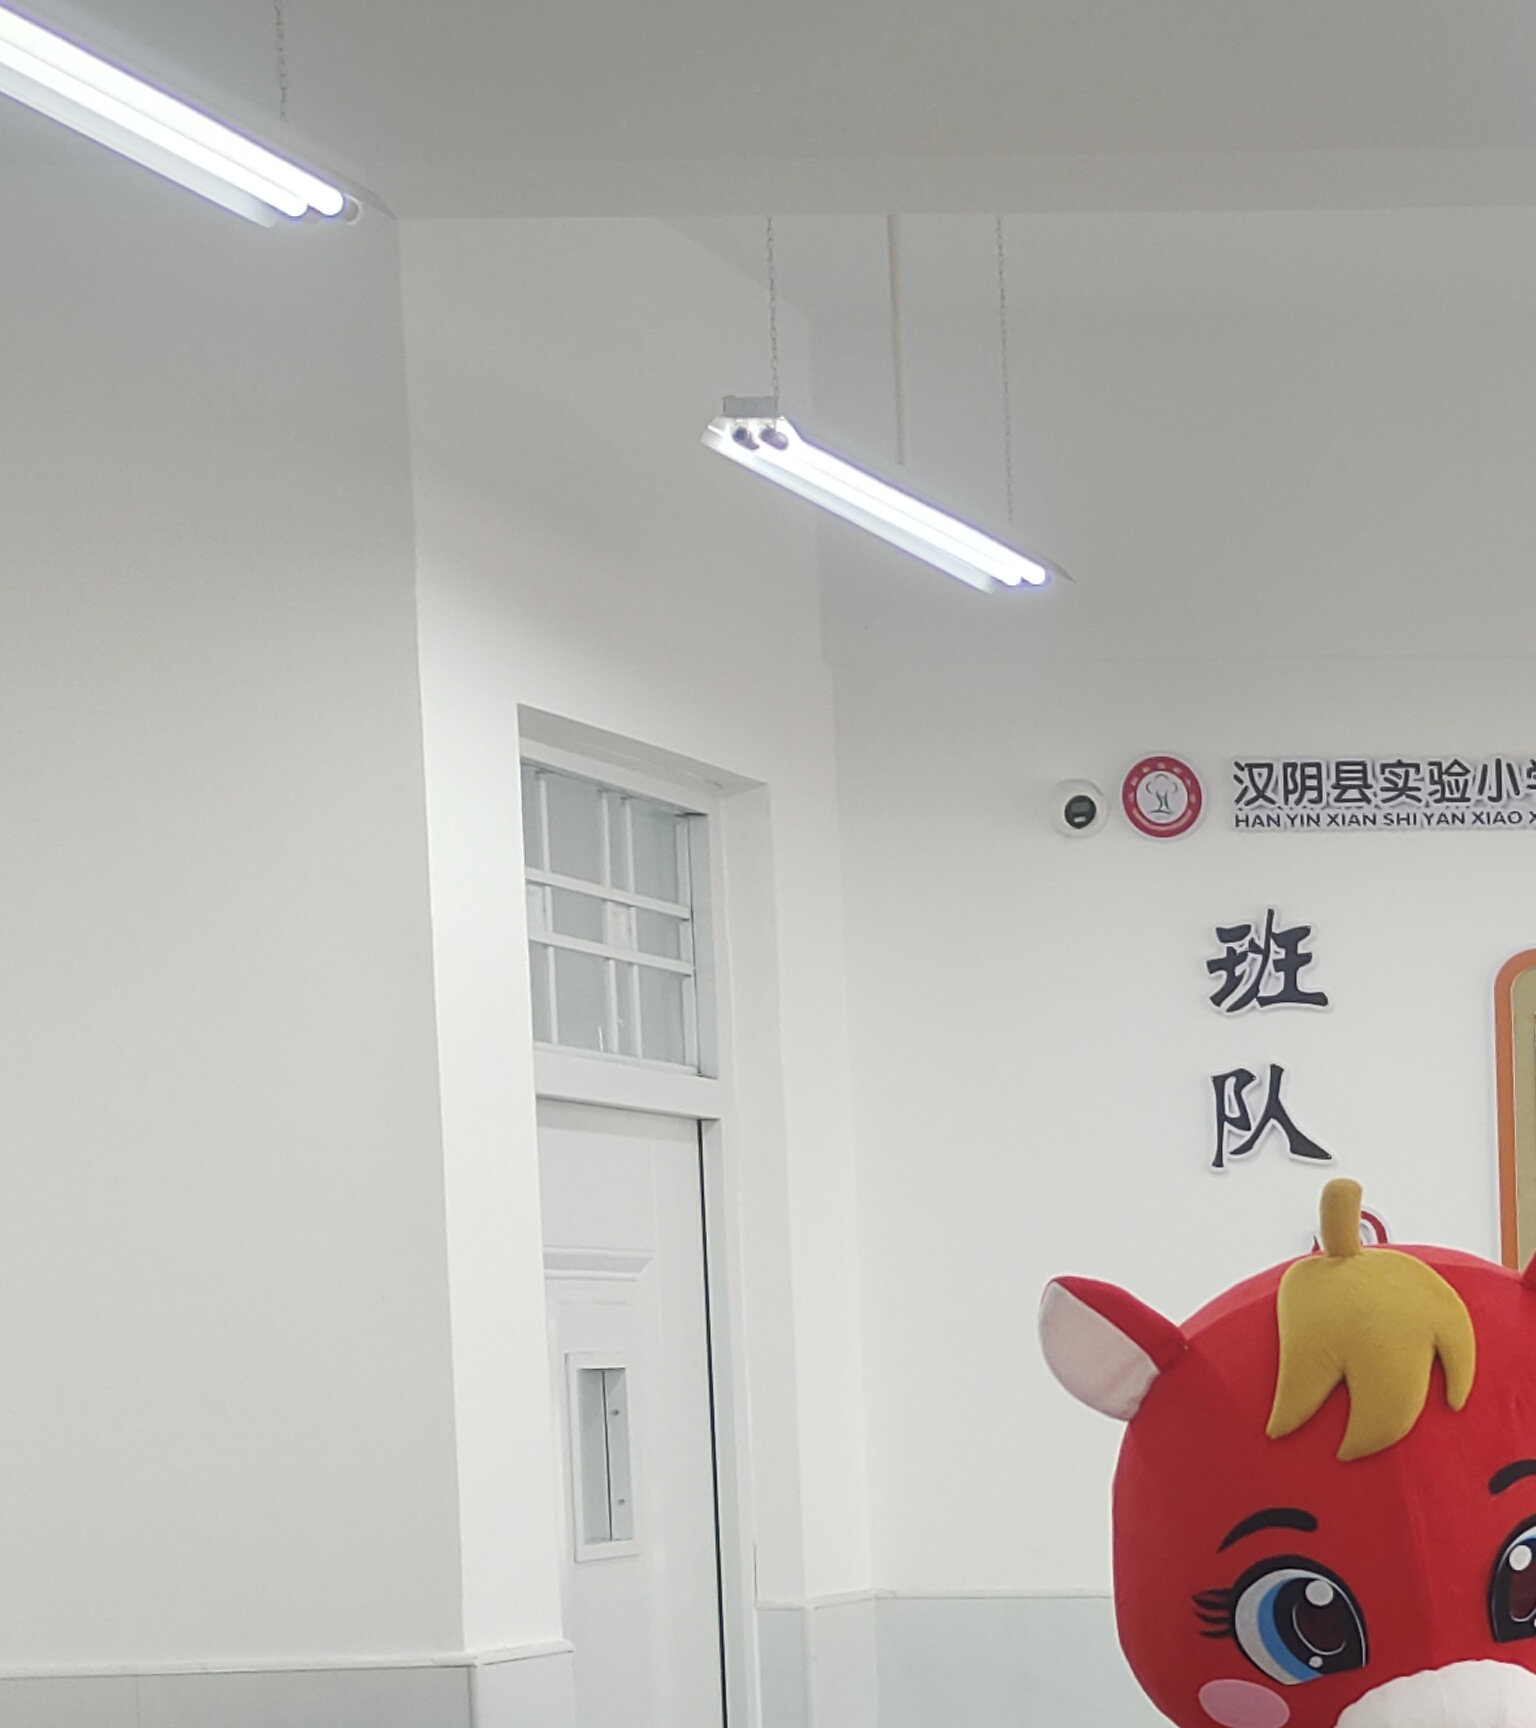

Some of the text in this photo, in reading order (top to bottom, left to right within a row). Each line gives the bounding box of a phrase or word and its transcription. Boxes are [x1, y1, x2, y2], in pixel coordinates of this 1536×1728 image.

[1235, 813, 1281, 828] HAN
[1286, 813, 1322, 827] YIN
[1327, 813, 1377, 827] XIAN
[1382, 812, 1417, 827] SHI
[1422, 812, 1466, 826] YAN
[1471, 811, 1523, 825] XIAO
[1207, 909, 1332, 1168] 班队
